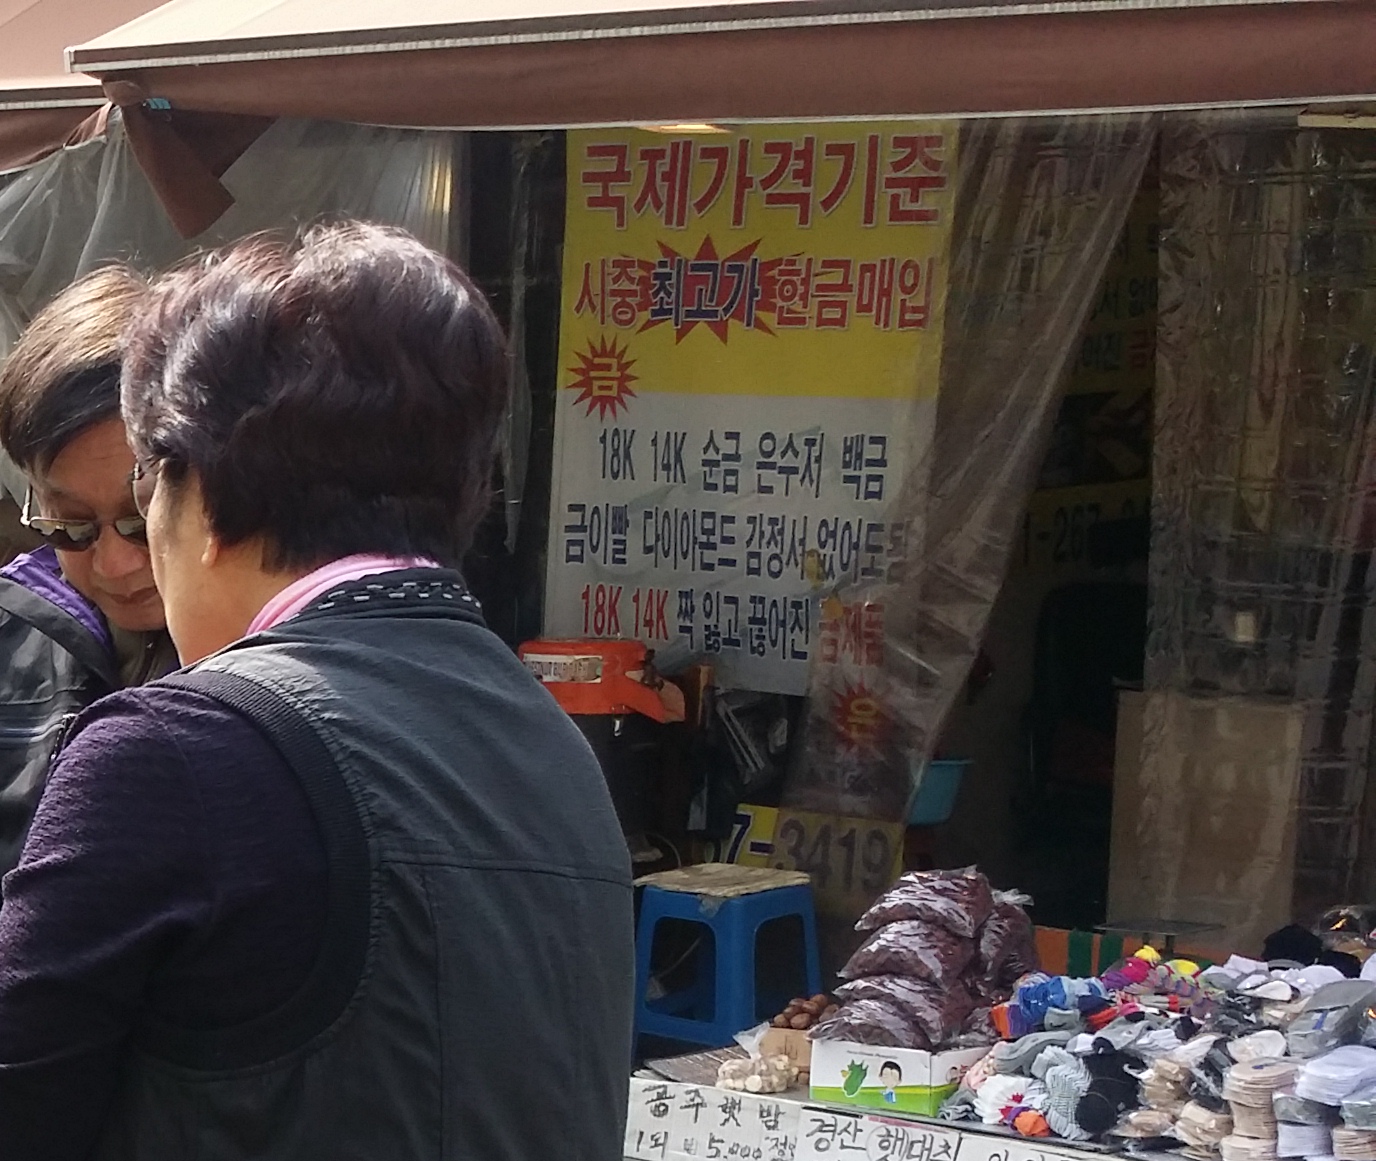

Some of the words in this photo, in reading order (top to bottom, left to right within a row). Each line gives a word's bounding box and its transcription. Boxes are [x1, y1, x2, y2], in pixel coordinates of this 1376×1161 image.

[580, 132, 949, 230] 국제가격기준
[589, 355, 623, 398] 금
[599, 427, 636, 481] 18K
[651, 430, 688, 484] 14K
[701, 429, 742, 494] 순금
[755, 431, 825, 499] 은수저
[841, 433, 888, 501] 백금
[564, 503, 630, 565] 금이빨
[642, 506, 738, 572] 다이아몬드
[745, 512, 808, 581] 감정서
[581, 583, 623, 636] 18K
[632, 587, 669, 640] 14K
[676, 587, 696, 650] 짝
[702, 590, 742, 653] 잃고
[747, 594, 810, 661] 끊어진
[705, 810, 890, 893] 7-3419
[805, 1115, 867, 1152] 경산
